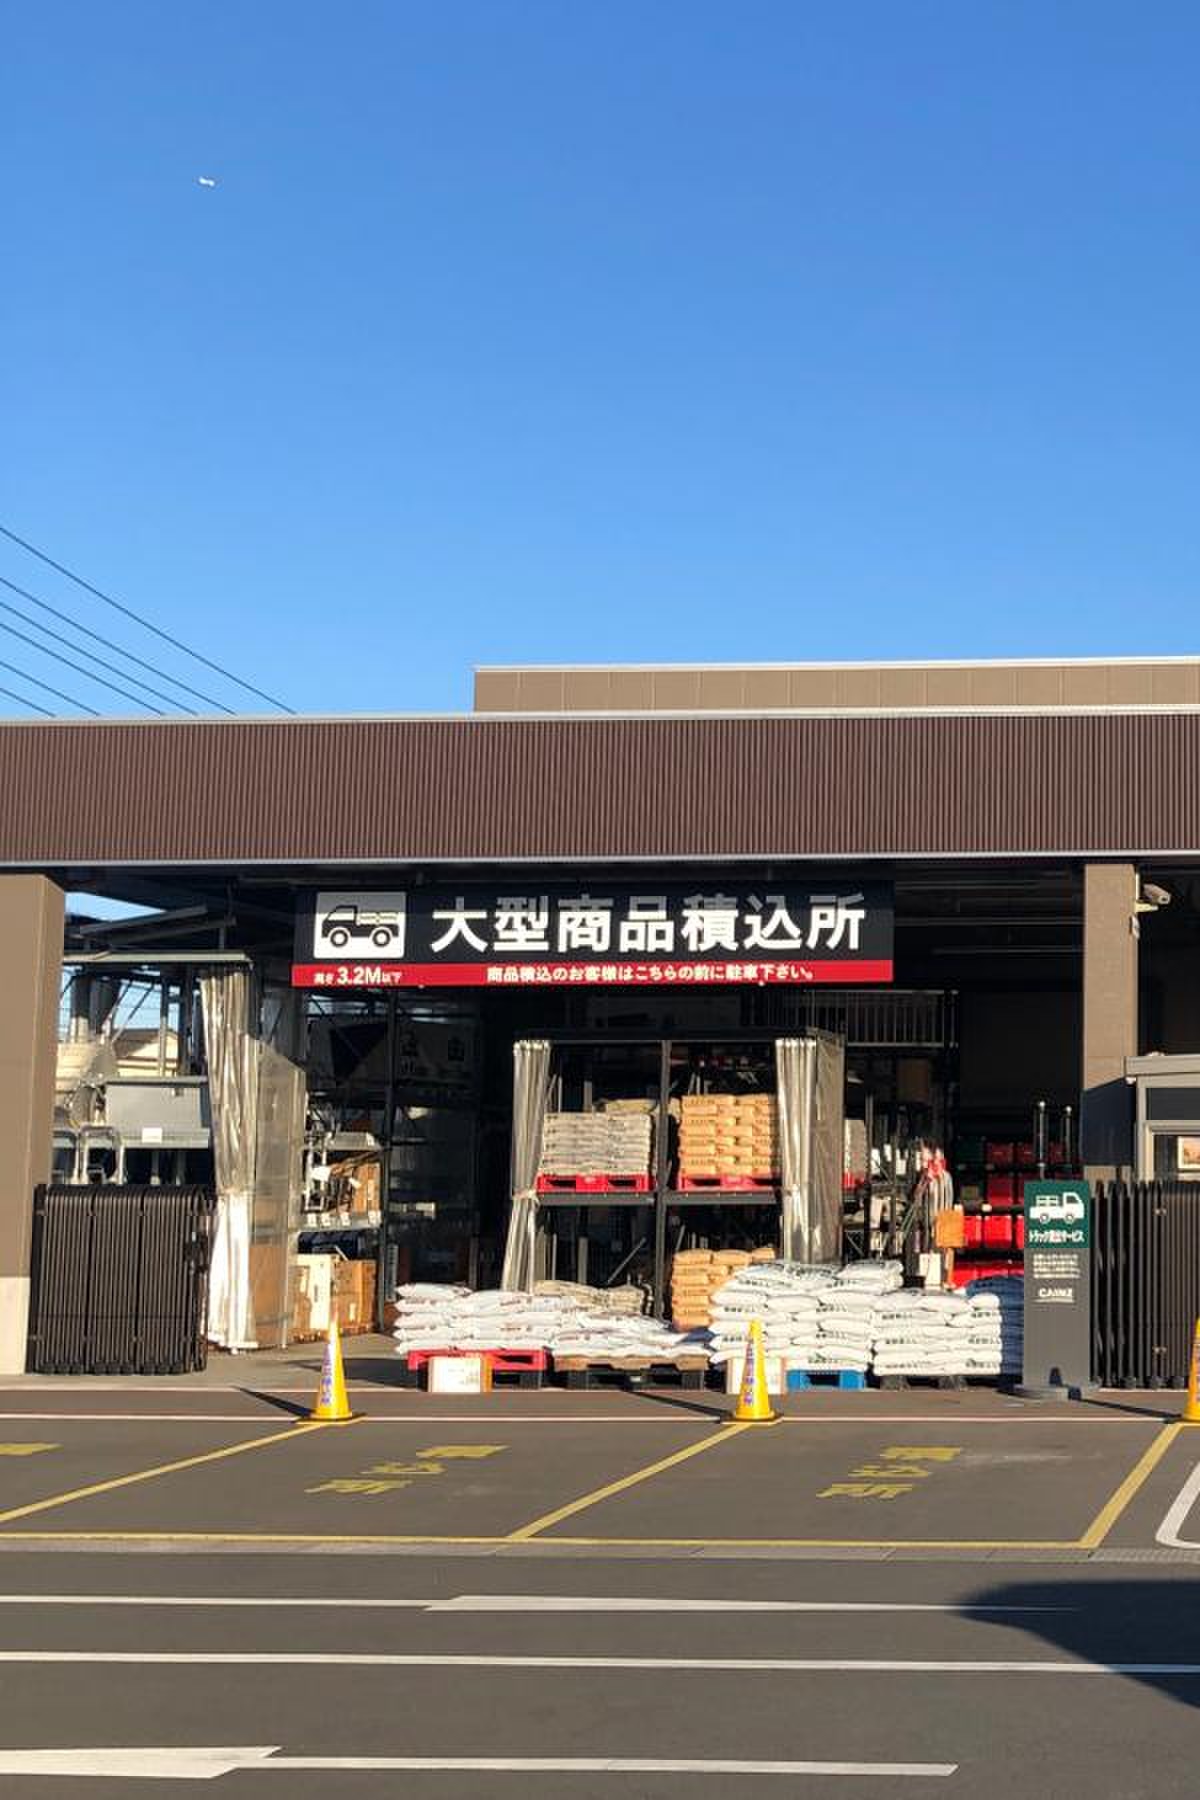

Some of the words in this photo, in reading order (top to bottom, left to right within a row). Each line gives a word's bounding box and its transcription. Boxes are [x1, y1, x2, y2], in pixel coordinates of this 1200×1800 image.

[430, 893, 865, 953] 大型商品積込所
